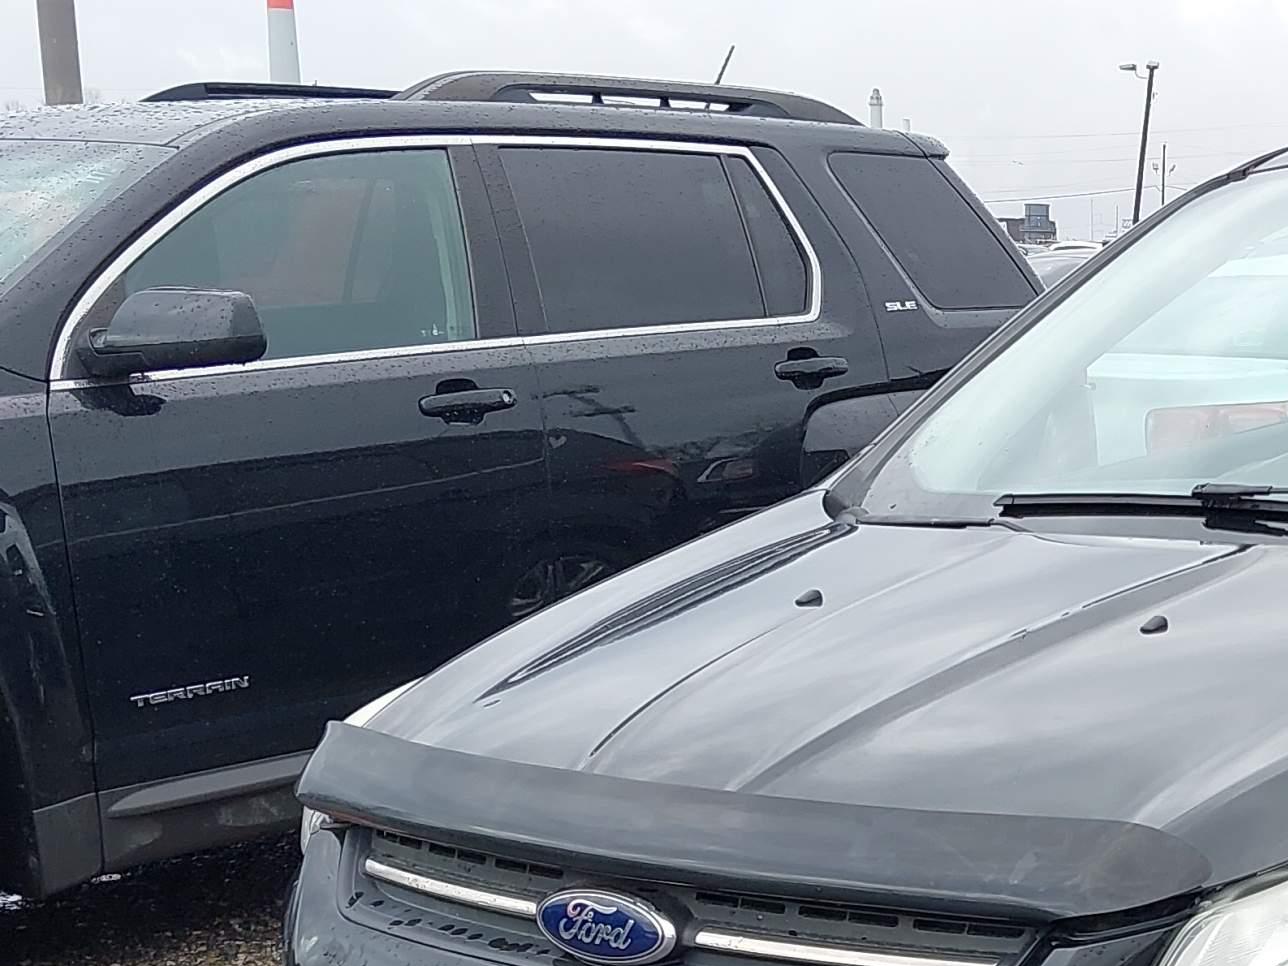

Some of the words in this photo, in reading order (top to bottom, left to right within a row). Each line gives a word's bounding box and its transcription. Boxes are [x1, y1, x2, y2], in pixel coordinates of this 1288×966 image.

[885, 300, 918, 311] SLE
[130, 675, 249, 707] TERRAIN
[558, 898, 635, 950] Ford
